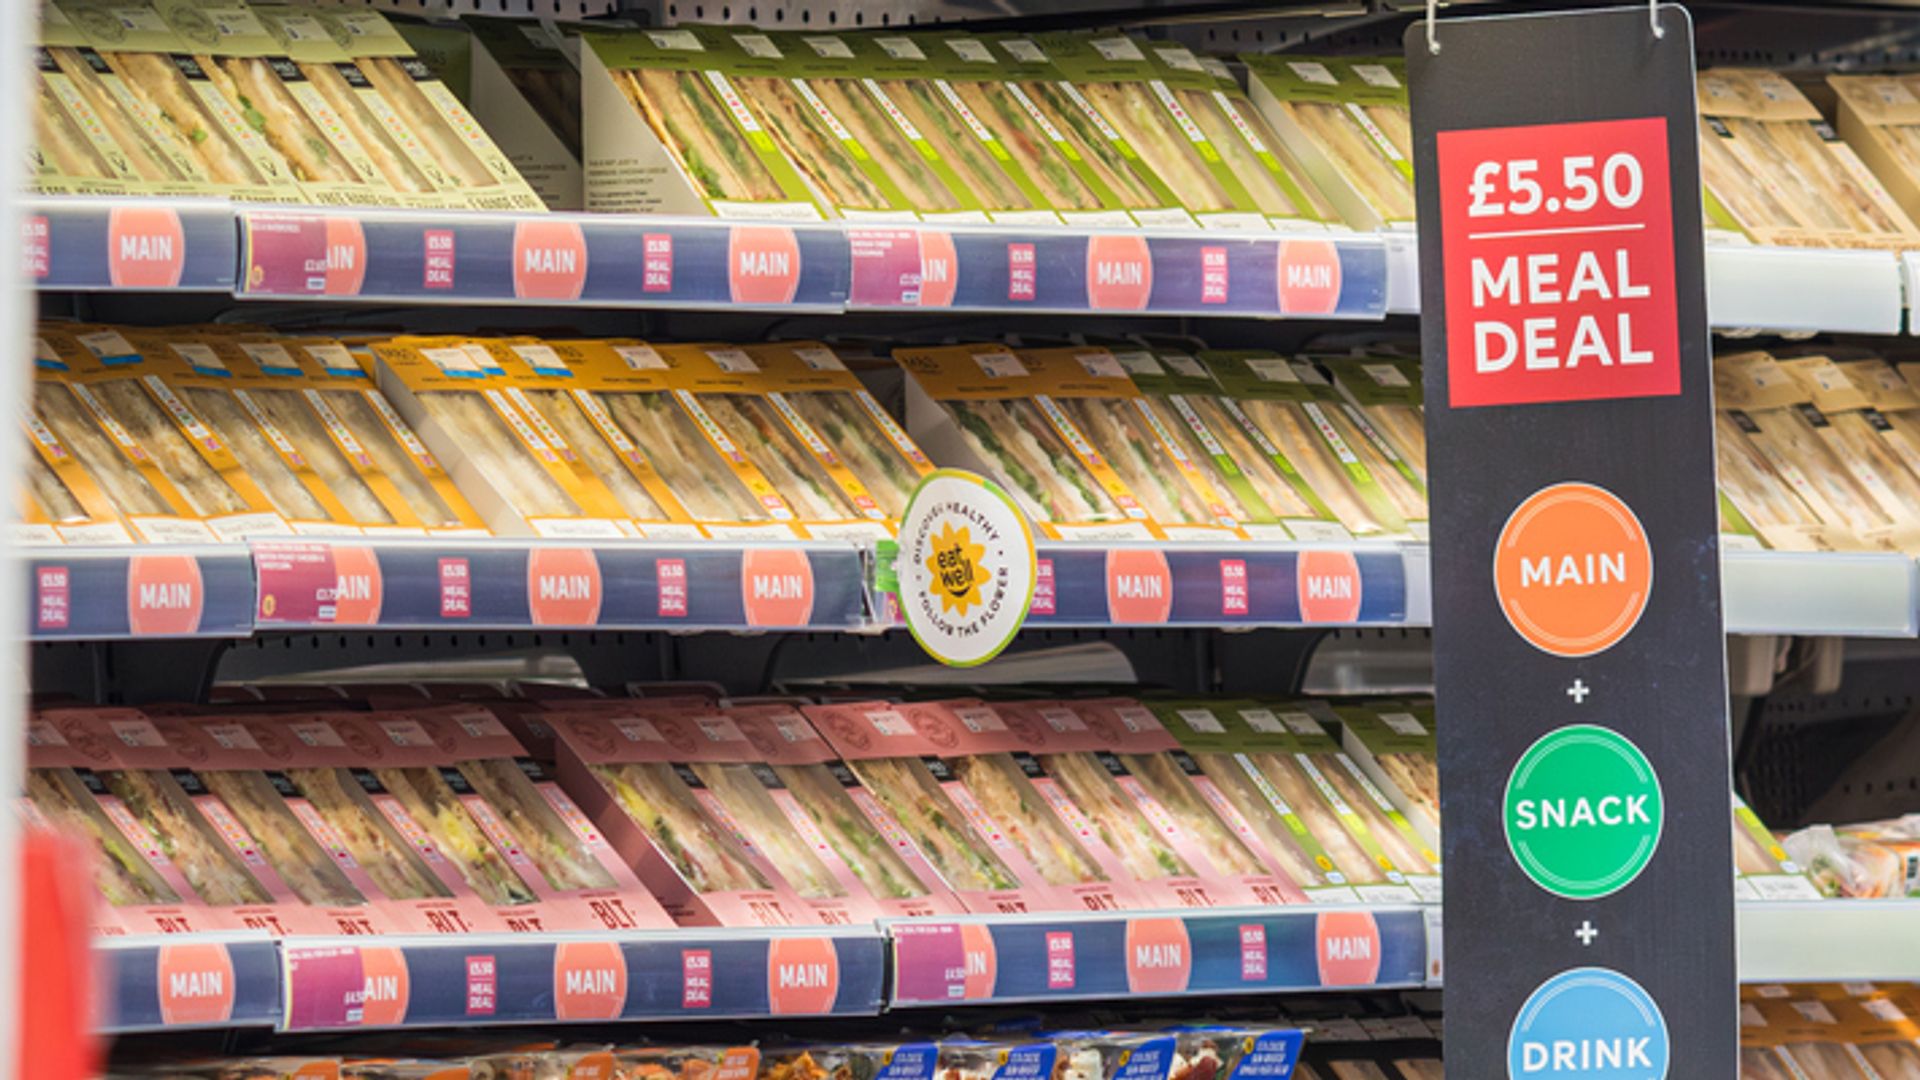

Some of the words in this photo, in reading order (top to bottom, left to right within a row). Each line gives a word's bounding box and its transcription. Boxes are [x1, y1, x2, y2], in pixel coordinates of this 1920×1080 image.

[1468, 152, 1644, 217] £5.50
[120, 235, 173, 260] MAIN
[326, 245, 354, 269] AIN
[525, 248, 576, 272] MAIN
[740, 251, 789, 275] MAIN
[427, 270, 451, 282] DEAL
[646, 274, 669, 285] DEAL
[1097, 261, 1142, 285] MAIN
[1287, 265, 1331, 288] MAIN
[1471, 249, 1650, 307] MEAL
[1011, 283, 1033, 294] DEAL
[1204, 286, 1225, 297] DEAL
[1474, 313, 1654, 373] DEAL
[946, 502, 1000, 541] HEALTHY
[937, 543, 963, 568] eat
[940, 558, 975, 587] well
[1520, 553, 1626, 587] MAIN
[140, 583, 191, 608] MAIN
[335, 575, 370, 599] AIN
[539, 575, 590, 598] MAIN
[753, 575, 802, 598] MAIN
[1117, 575, 1162, 598] MAIN
[1307, 576, 1352, 599] MAIN
[443, 599, 468, 611] DEAL
[661, 599, 685, 610] DEAL
[919, 591, 954, 635] FOLLOW
[957, 623, 980, 638] THE
[980, 567, 1009, 626] FLOWER
[1225, 598, 1246, 609] DEAL
[41, 610, 66, 621] DEAL
[1516, 794, 1650, 829] SNACK
[589, 900, 638, 929] BLT
[1136, 944, 1181, 967] MAIN
[1326, 936, 1371, 960] MAIN
[967, 952, 986, 974] IN
[1243, 963, 1265, 974] DEAL
[170, 971, 222, 997] MAIN
[565, 969, 616, 993] MAIN
[779, 964, 828, 987] MAIN
[1050, 972, 1072, 982] DEAL
[363, 976, 398, 1000] AIN
[685, 991, 709, 1001] DEAL
[469, 997, 493, 1008] DEAL
[1523, 1036, 1652, 1072] DRINK
